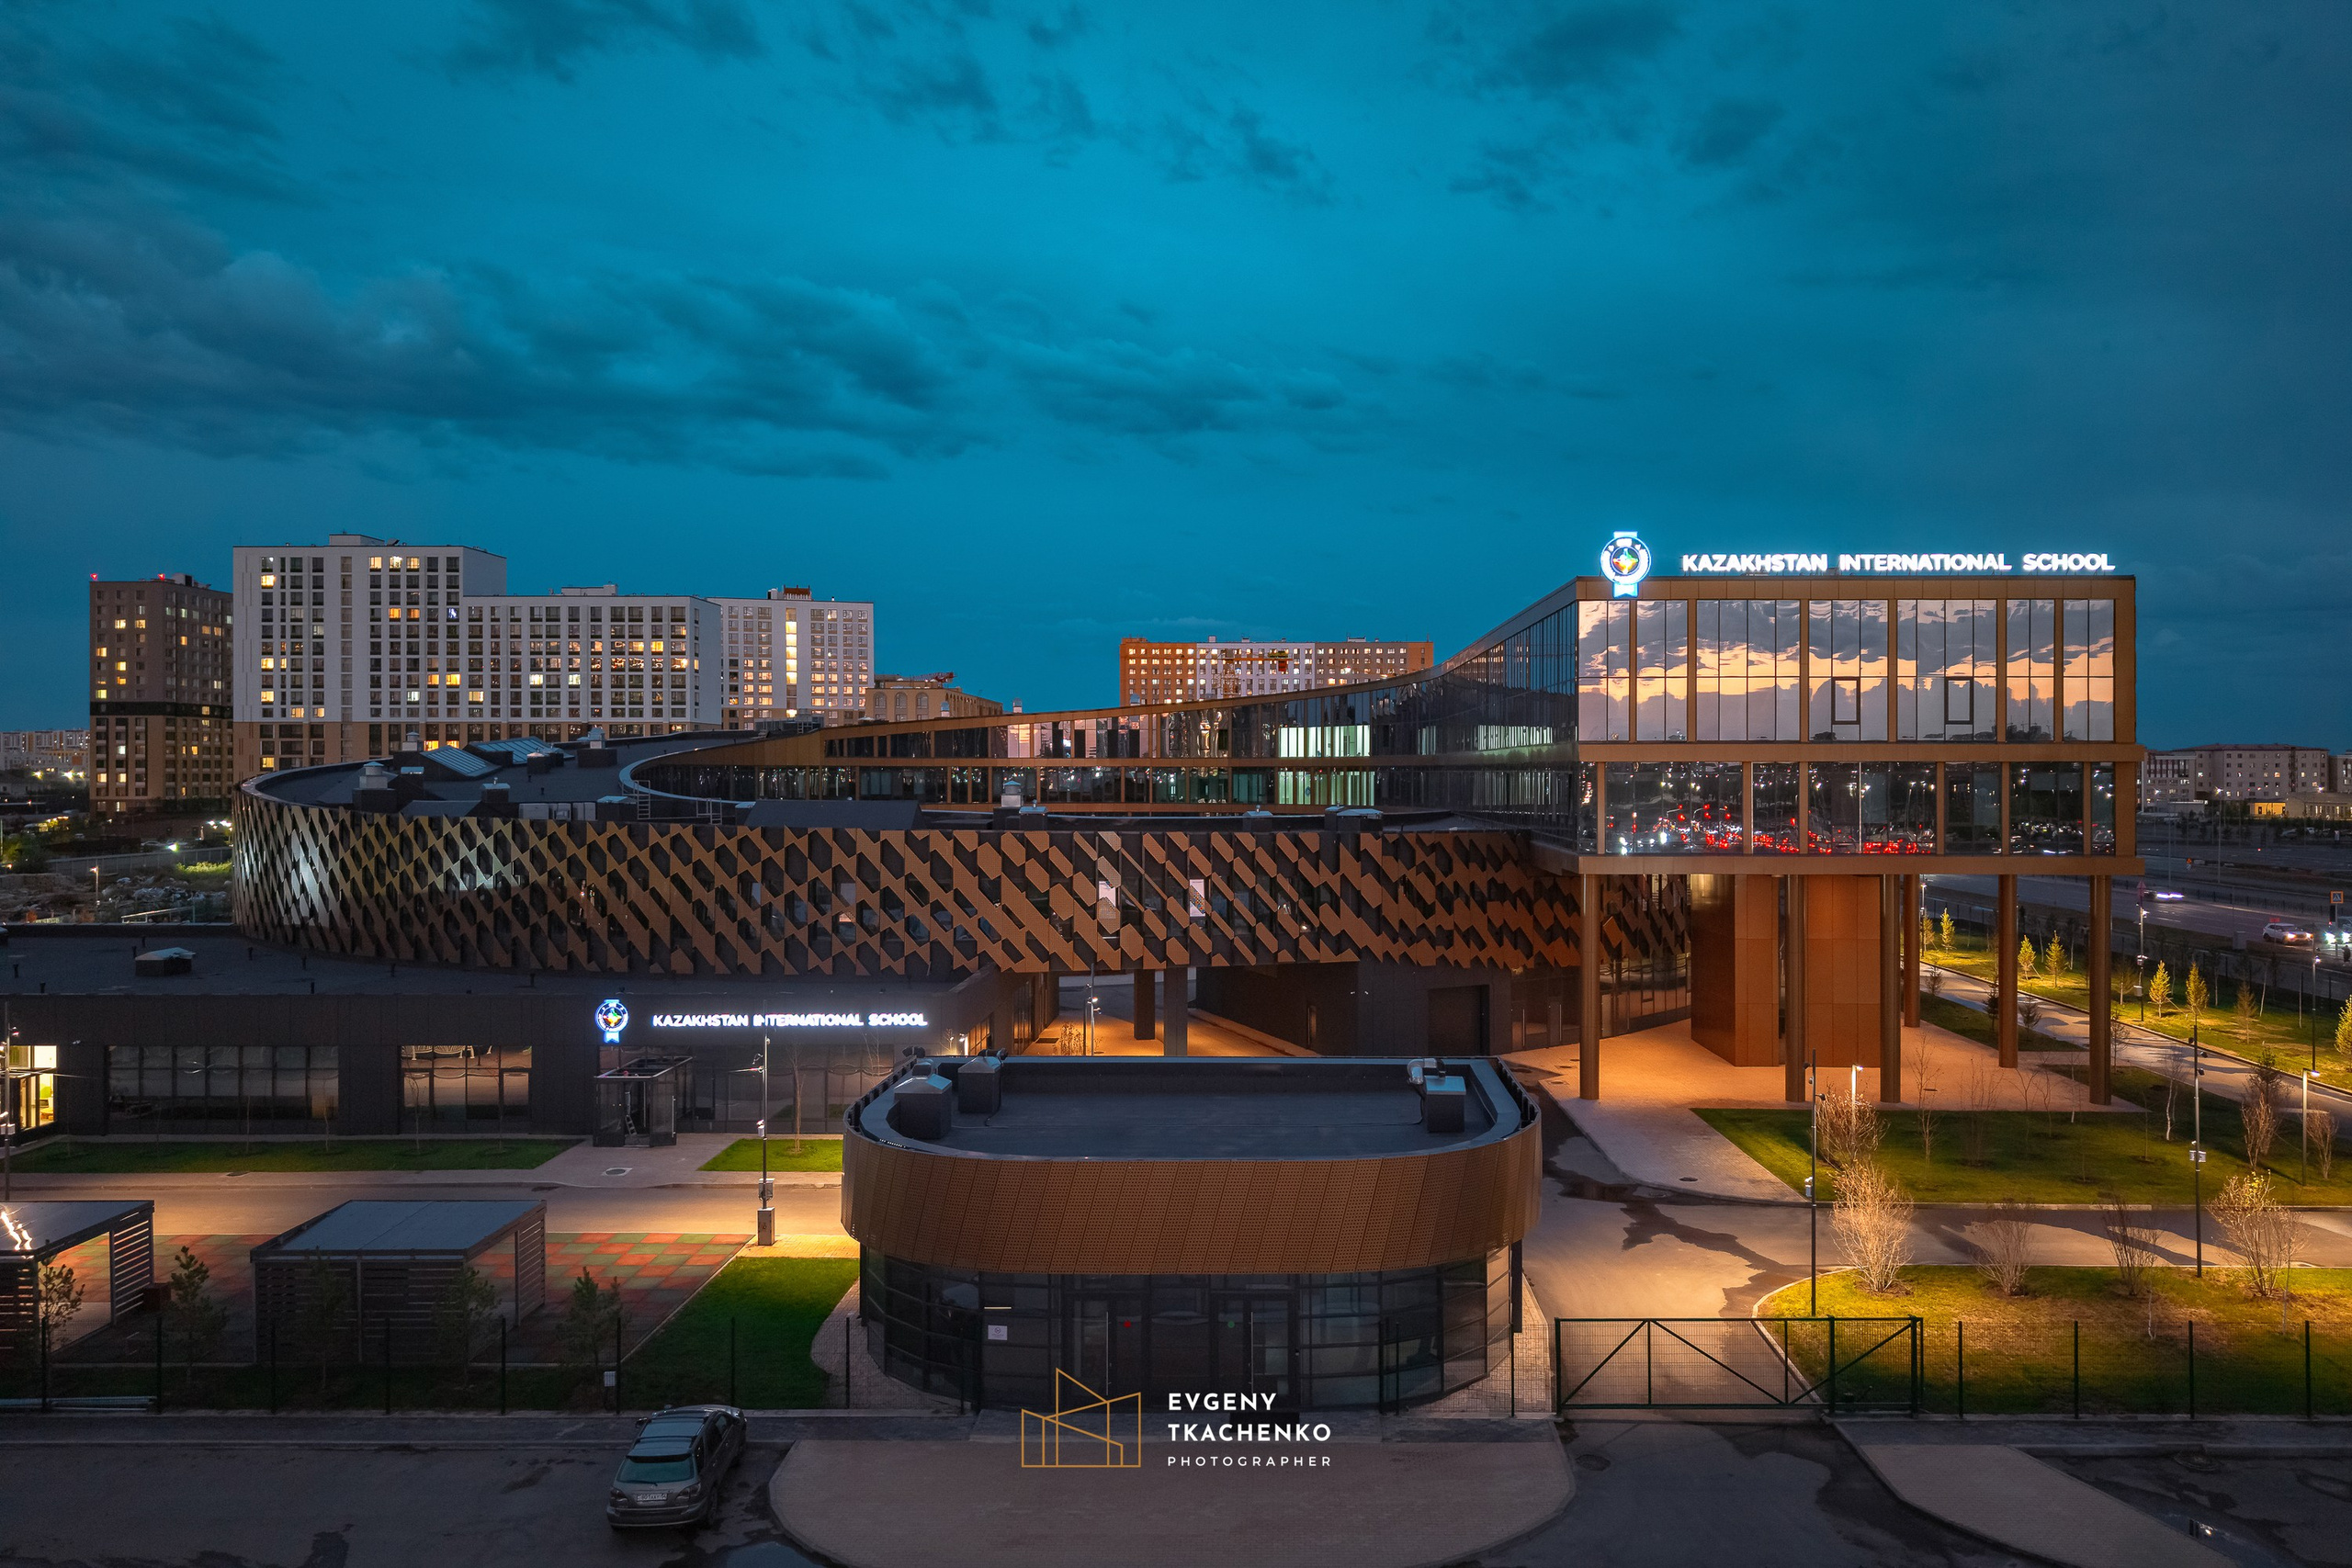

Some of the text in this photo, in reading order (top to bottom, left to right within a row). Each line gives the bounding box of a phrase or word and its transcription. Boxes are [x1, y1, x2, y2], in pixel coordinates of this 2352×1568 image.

[1682, 553, 2116, 572] KAZAKHSTAN INTERNATIONAL SCHOOL
[652, 1012, 928, 1027] KAZAKHSTAN INTERNATIONAL SCHOOL
